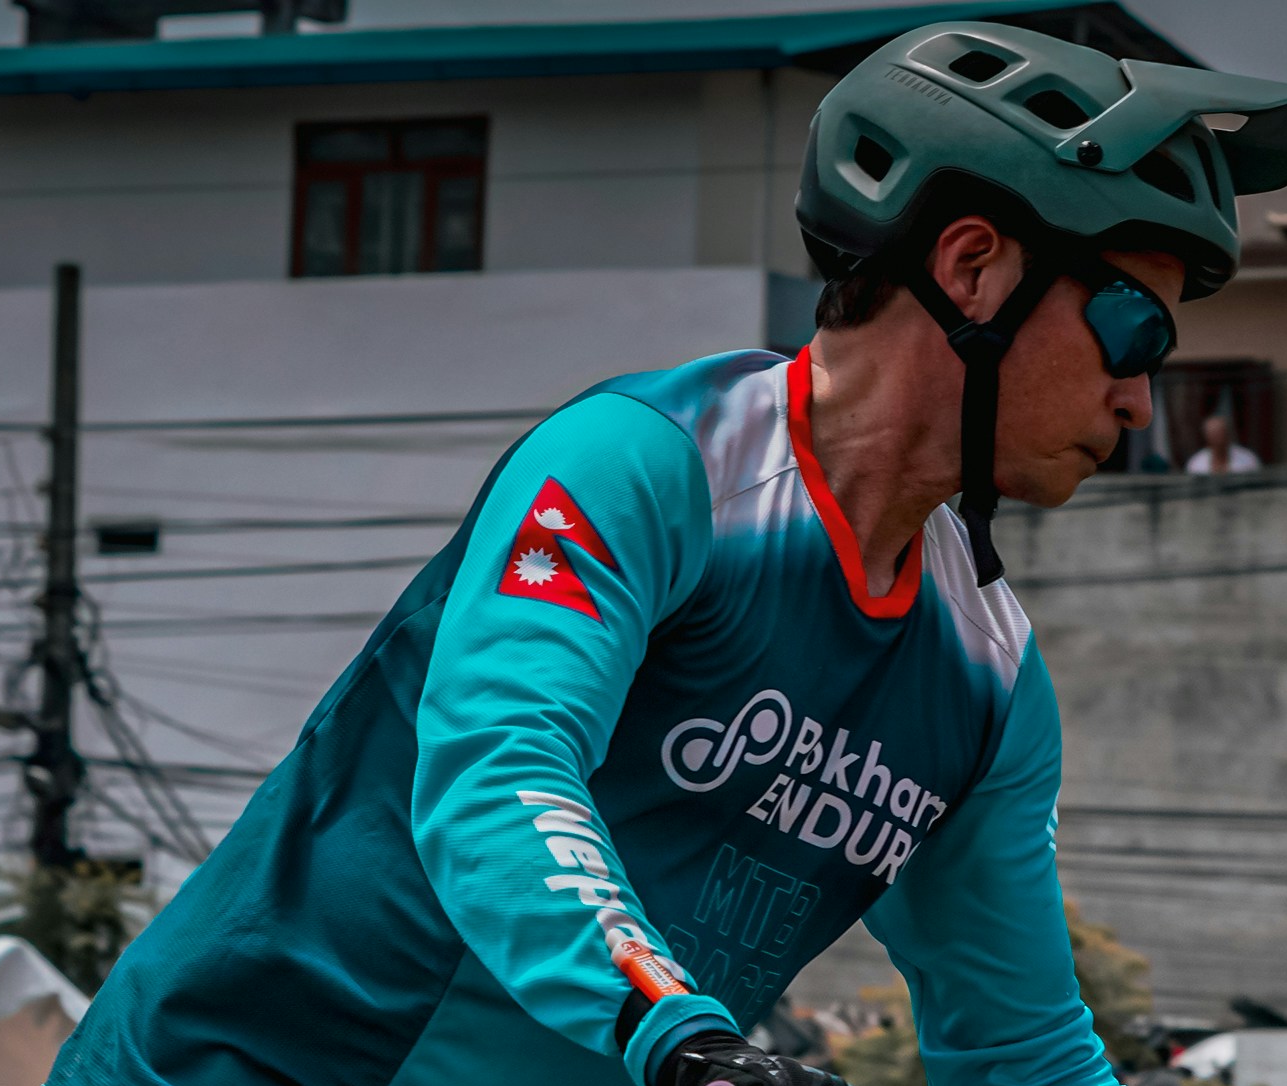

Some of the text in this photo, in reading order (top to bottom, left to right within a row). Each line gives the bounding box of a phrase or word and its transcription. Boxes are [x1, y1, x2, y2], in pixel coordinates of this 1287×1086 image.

[745, 773, 922, 885] ENDUR
[784, 715, 948, 829] Pokhar
[693, 842, 821, 959] MTB
